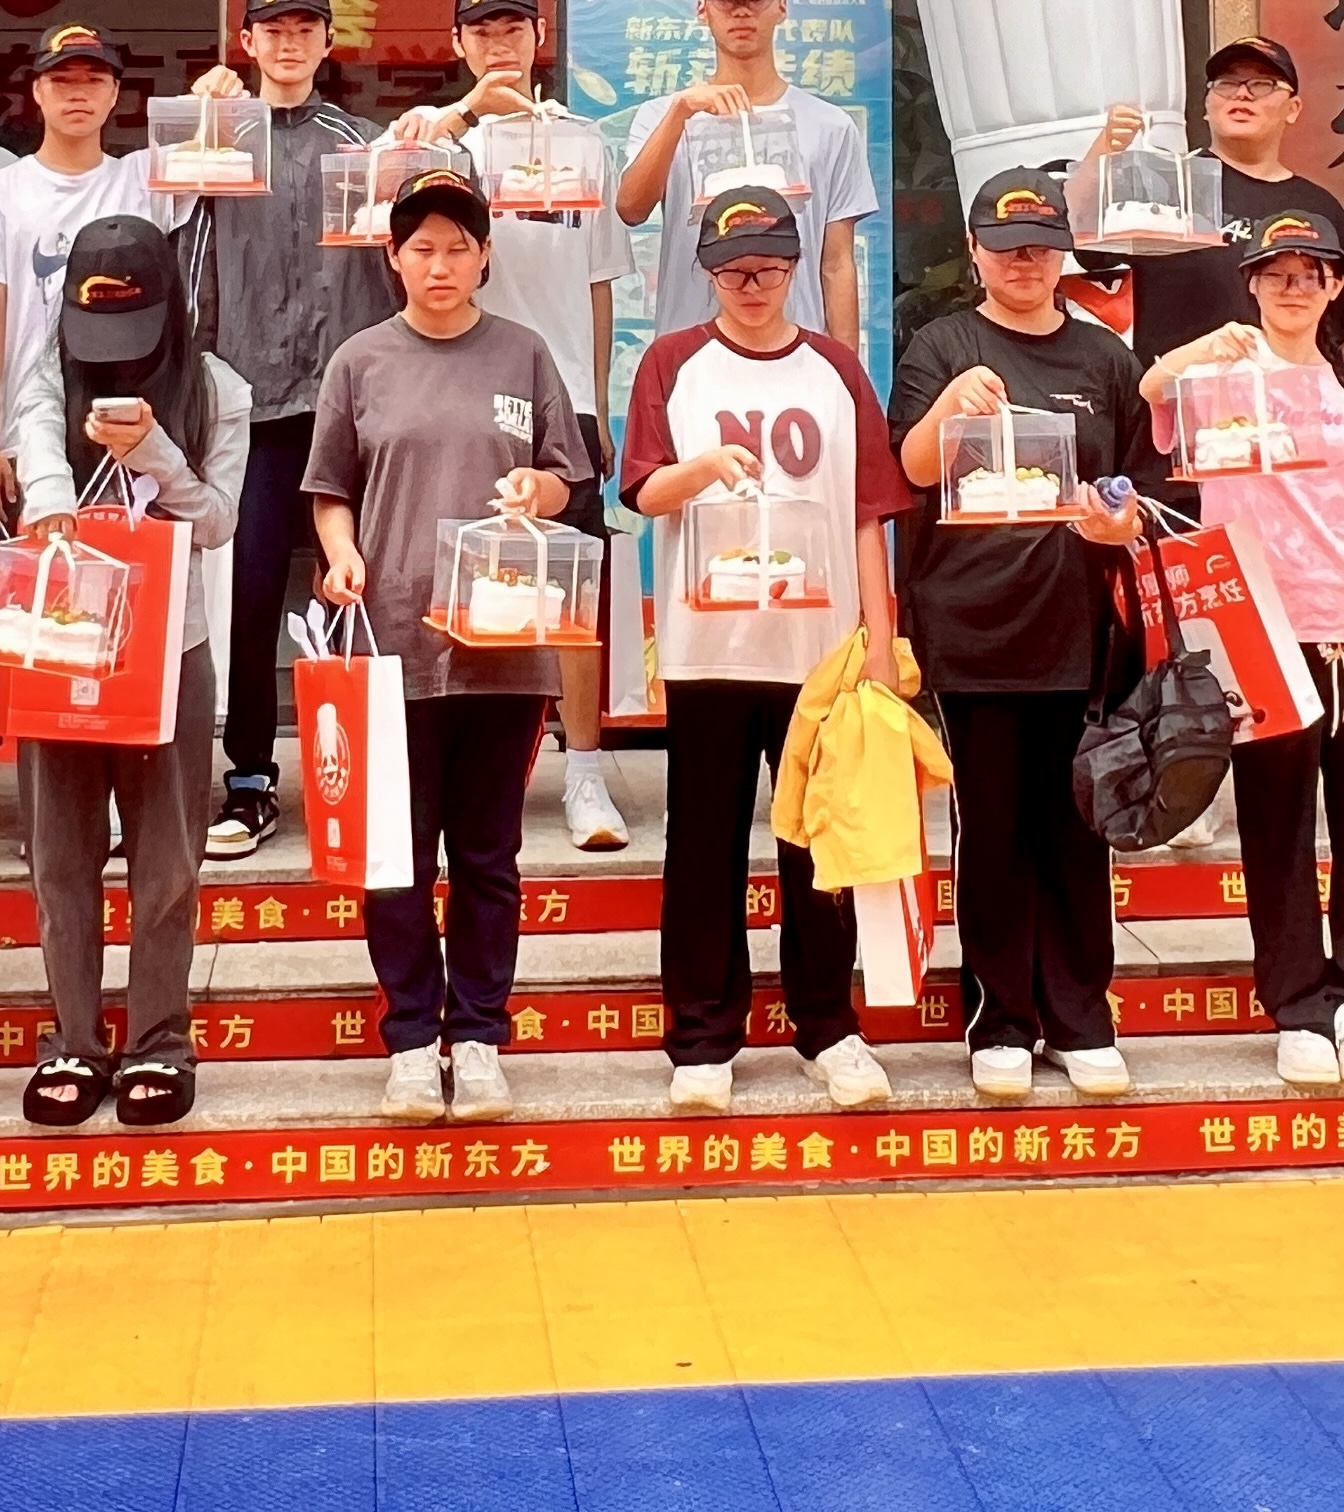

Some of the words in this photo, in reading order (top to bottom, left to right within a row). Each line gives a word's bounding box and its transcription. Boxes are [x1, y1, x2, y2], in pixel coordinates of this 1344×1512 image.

[714, 407, 821, 478] NO
[608, 1122, 1142, 1175] 世界的美食·中国的新东方
